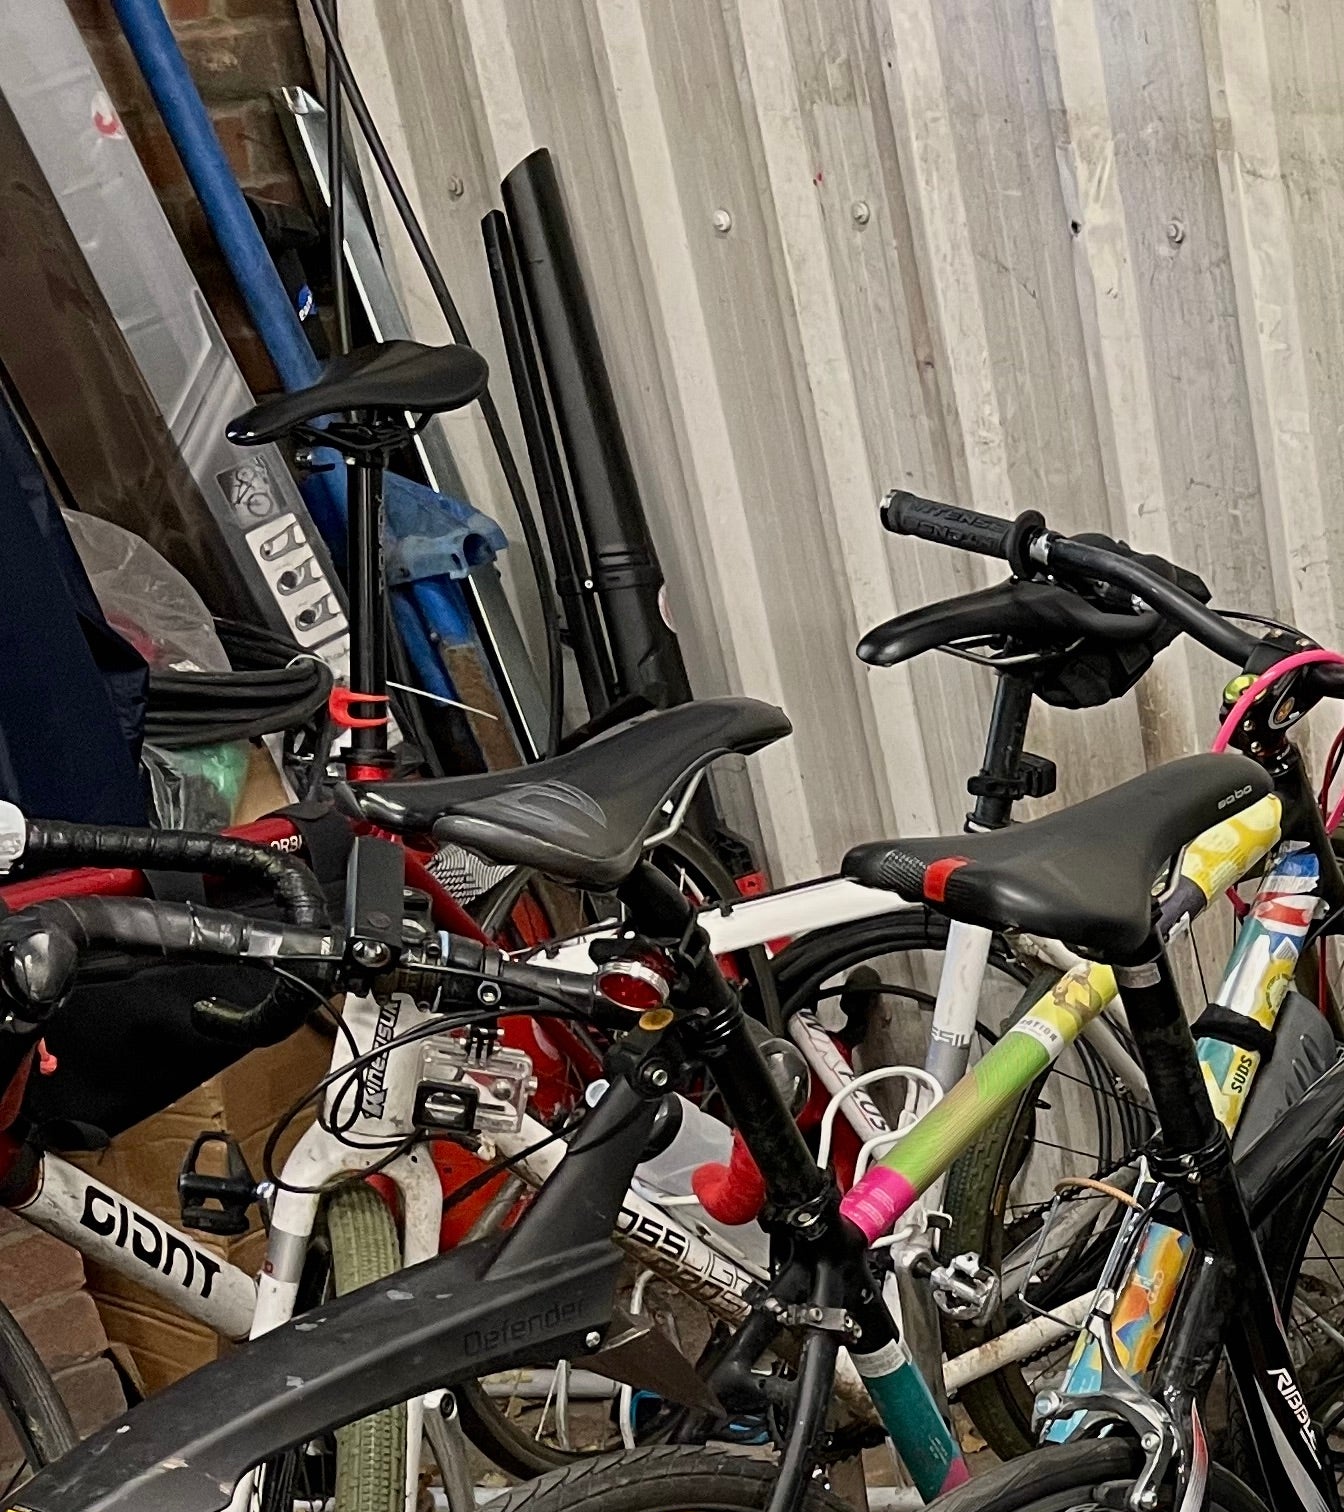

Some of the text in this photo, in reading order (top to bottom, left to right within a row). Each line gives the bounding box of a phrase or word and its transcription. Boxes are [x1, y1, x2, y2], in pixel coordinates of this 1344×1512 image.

[1230, 1053, 1254, 1094] SUDS
[79, 1185, 223, 1299] GIANT
[463, 1294, 593, 1361] Defender
